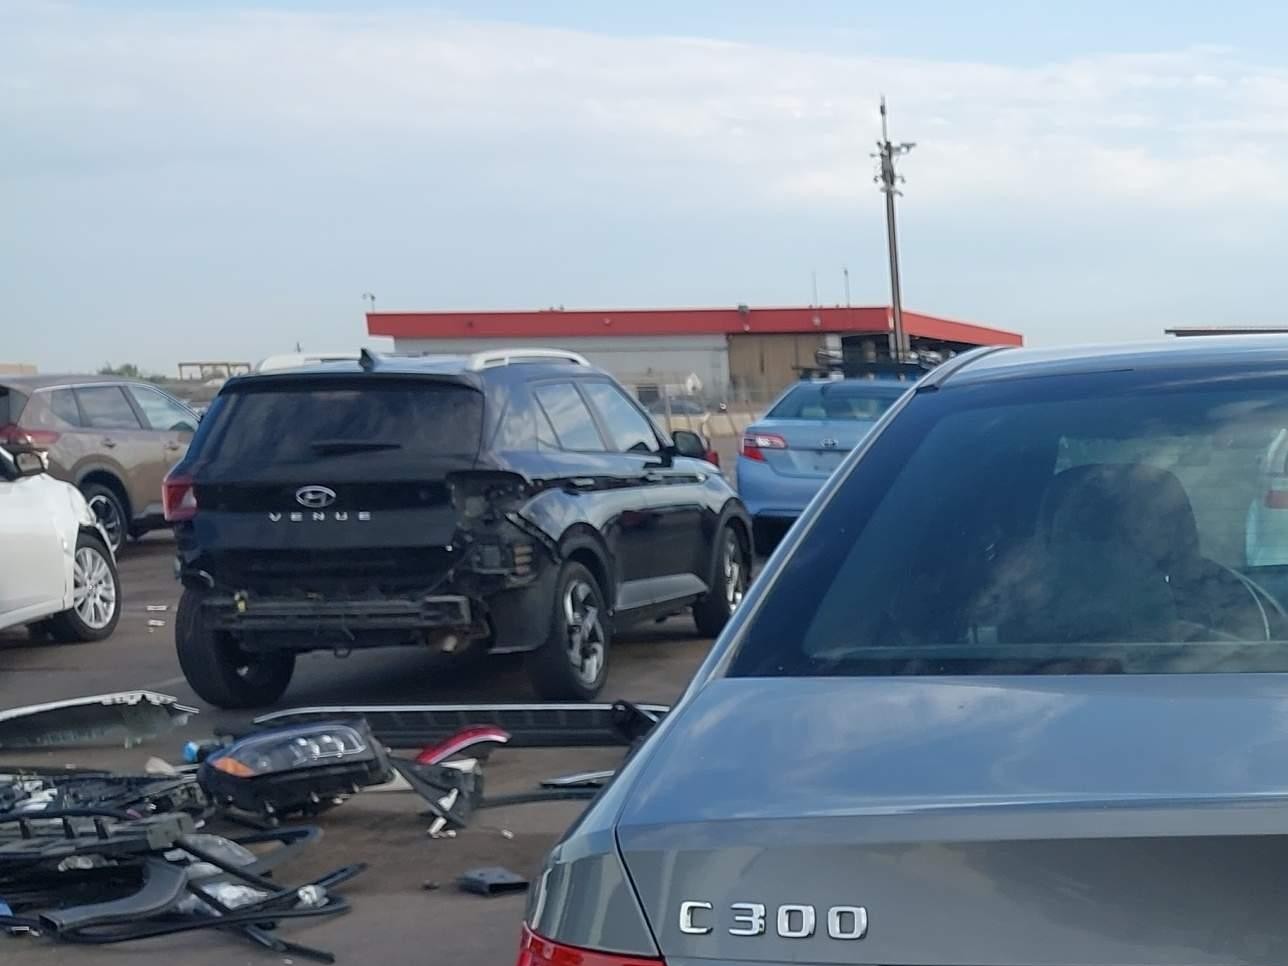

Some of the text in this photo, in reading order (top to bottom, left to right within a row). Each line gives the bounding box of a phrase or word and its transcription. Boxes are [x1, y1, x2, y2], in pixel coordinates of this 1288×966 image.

[268, 511, 371, 521] VENUE
[679, 901, 868, 939] C 300
